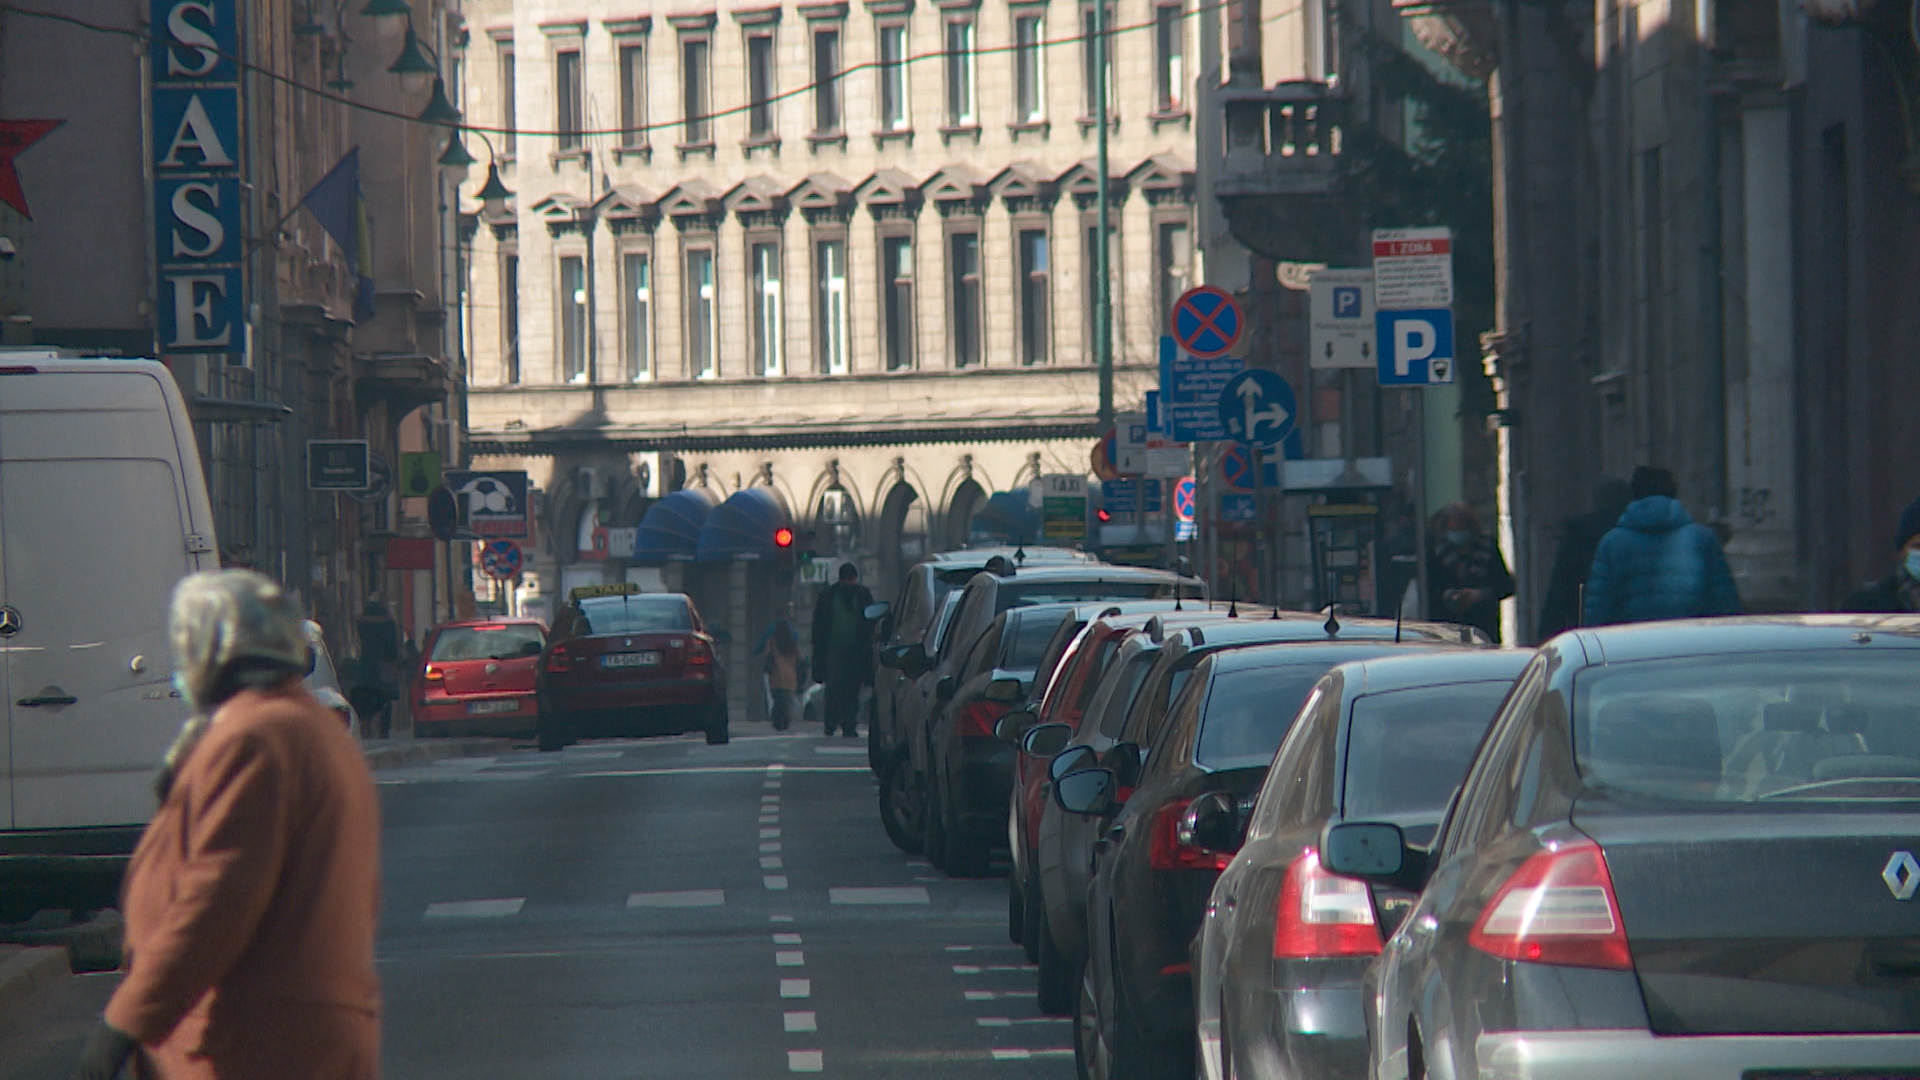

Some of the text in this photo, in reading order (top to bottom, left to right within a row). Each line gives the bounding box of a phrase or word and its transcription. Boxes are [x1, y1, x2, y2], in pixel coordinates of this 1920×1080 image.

[1399, 241, 1434, 254] ZONA
[1338, 291, 1356, 314] P
[1393, 318, 1437, 377] P
[1052, 477, 1080, 492] TAXI
